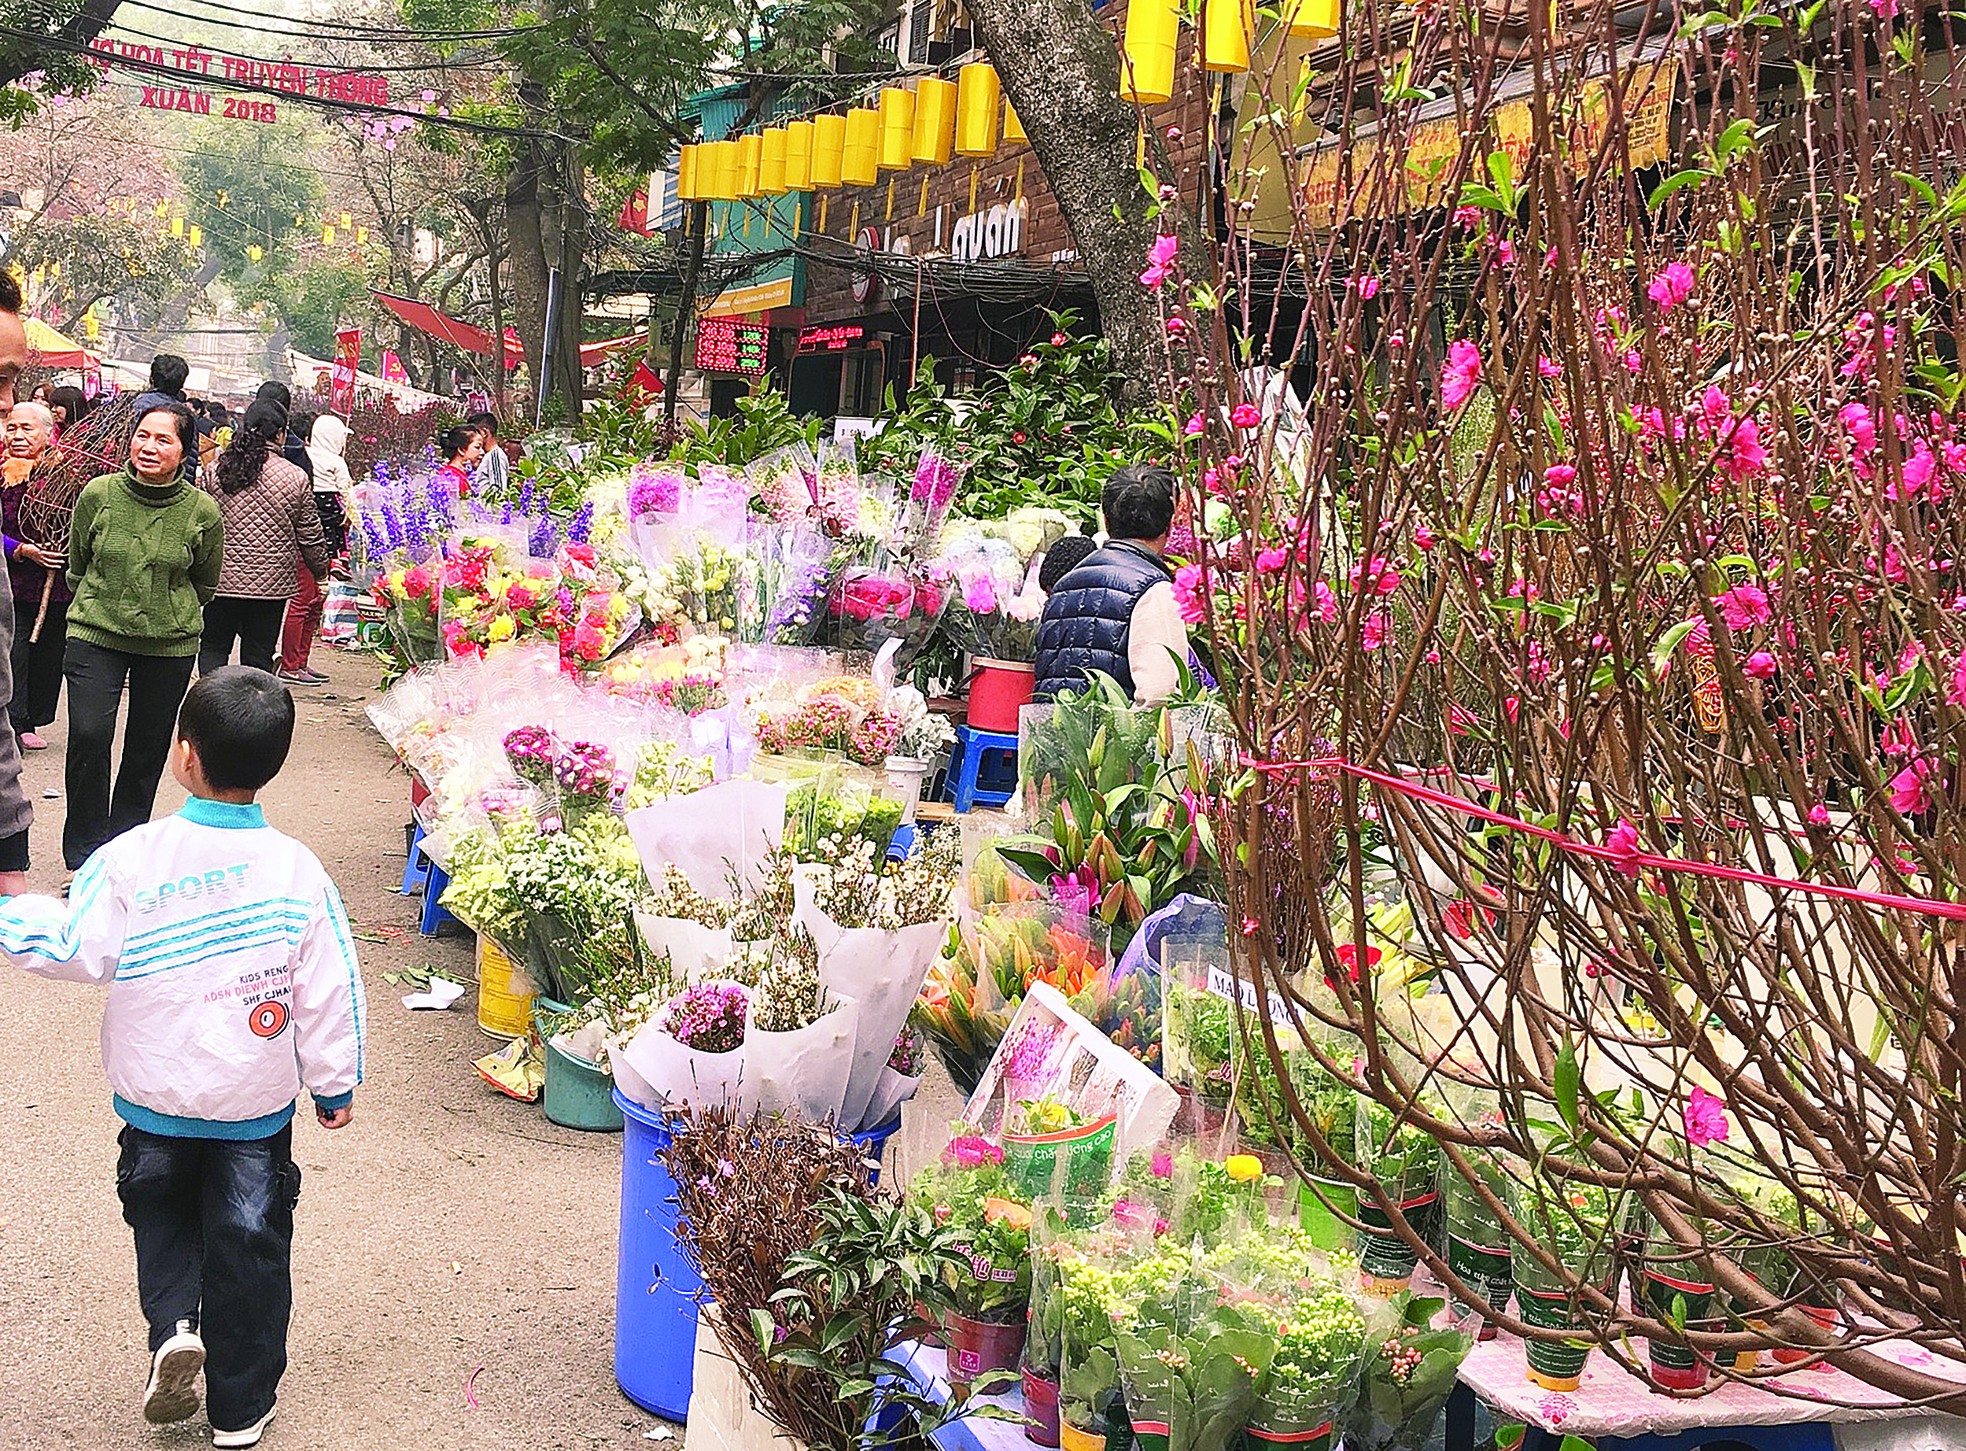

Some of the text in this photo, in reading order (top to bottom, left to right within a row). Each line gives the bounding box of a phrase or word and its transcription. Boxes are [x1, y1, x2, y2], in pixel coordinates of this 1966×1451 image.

[140, 85, 276, 123] XUÂN 2018
[135, 863, 249, 915] SPORT
[239, 964, 289, 984] KIDS RENG
[203, 989, 232, 1004] ADSN
[235, 980, 269, 997] DIEWH
[242, 994, 261, 1006] SHF
[1094, 1129, 1111, 1146] cao
[1456, 1261, 1471, 1275] Hoa
